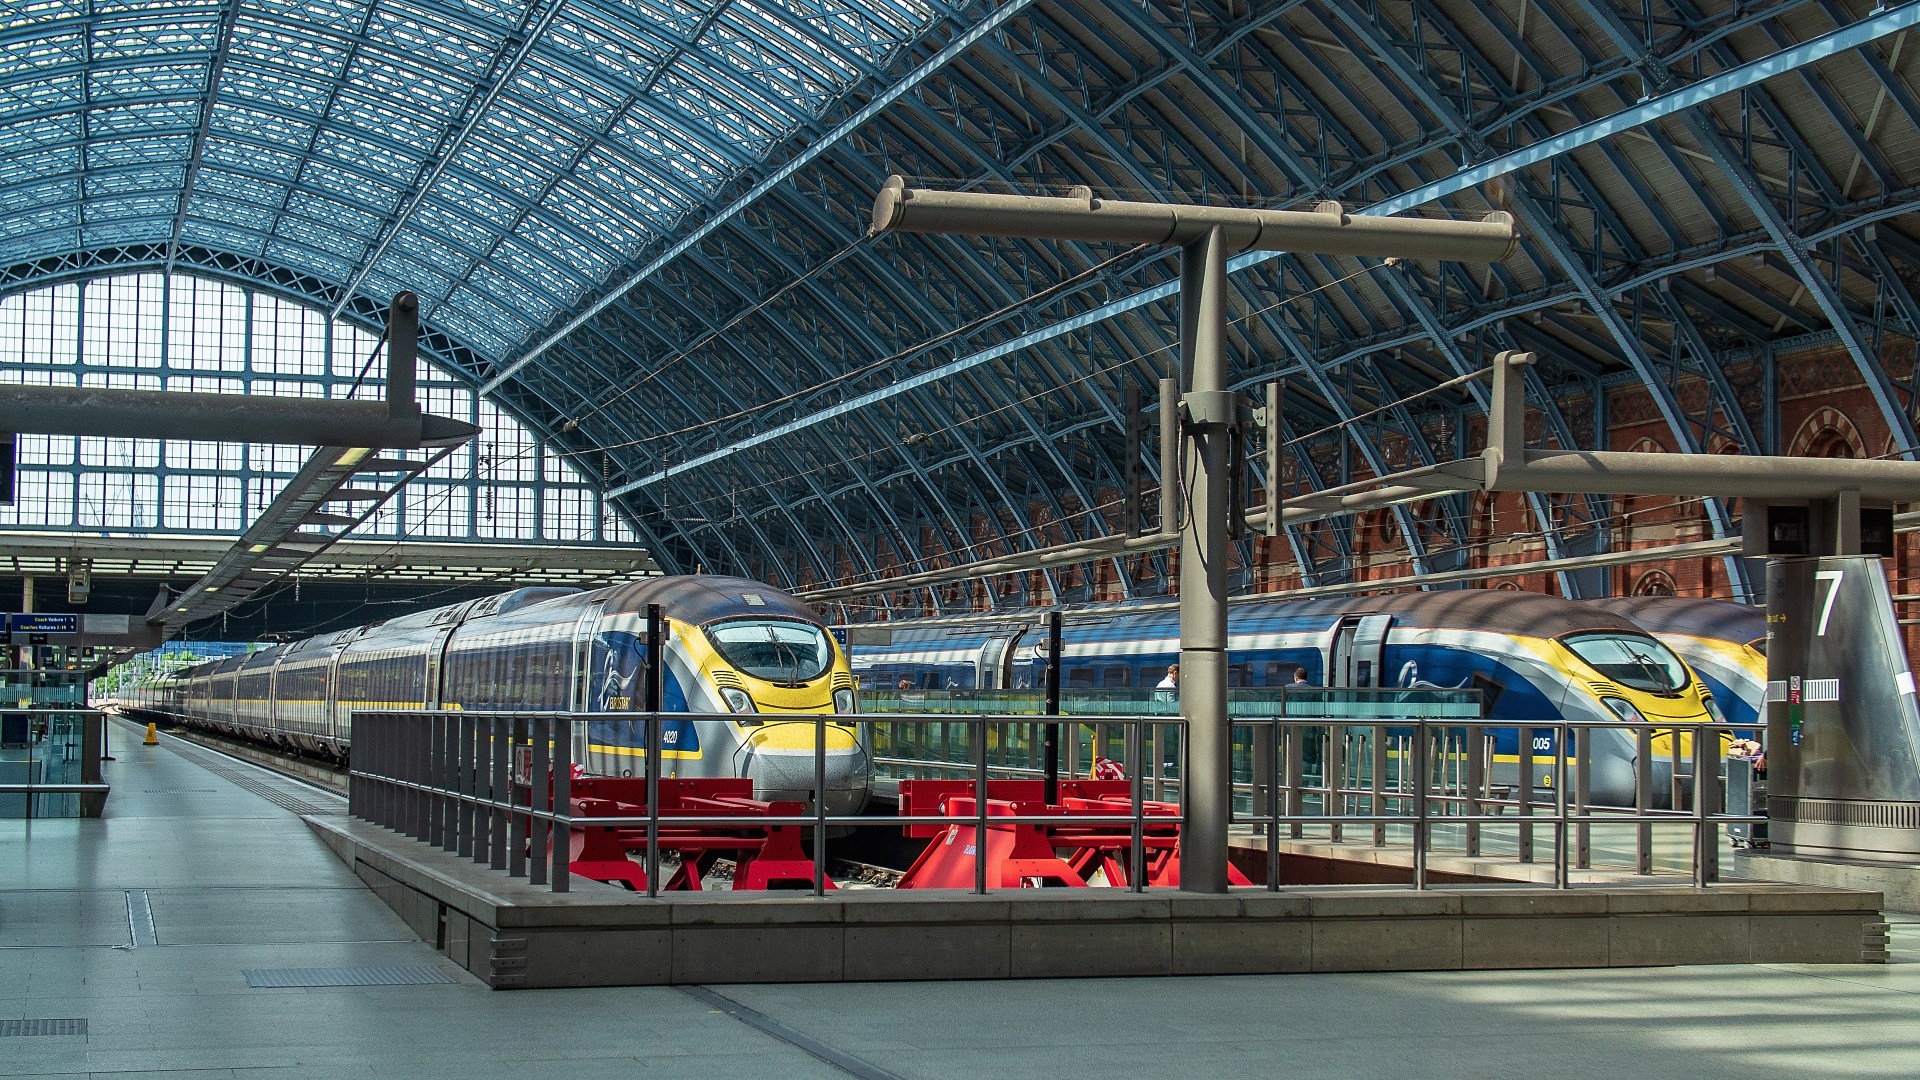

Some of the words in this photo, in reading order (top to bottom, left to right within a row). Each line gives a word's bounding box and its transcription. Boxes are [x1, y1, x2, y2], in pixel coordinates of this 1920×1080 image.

[1815, 571, 1843, 636] 7
[610, 697, 629, 709] EUROSTAR
[663, 731, 678, 744] 4020
